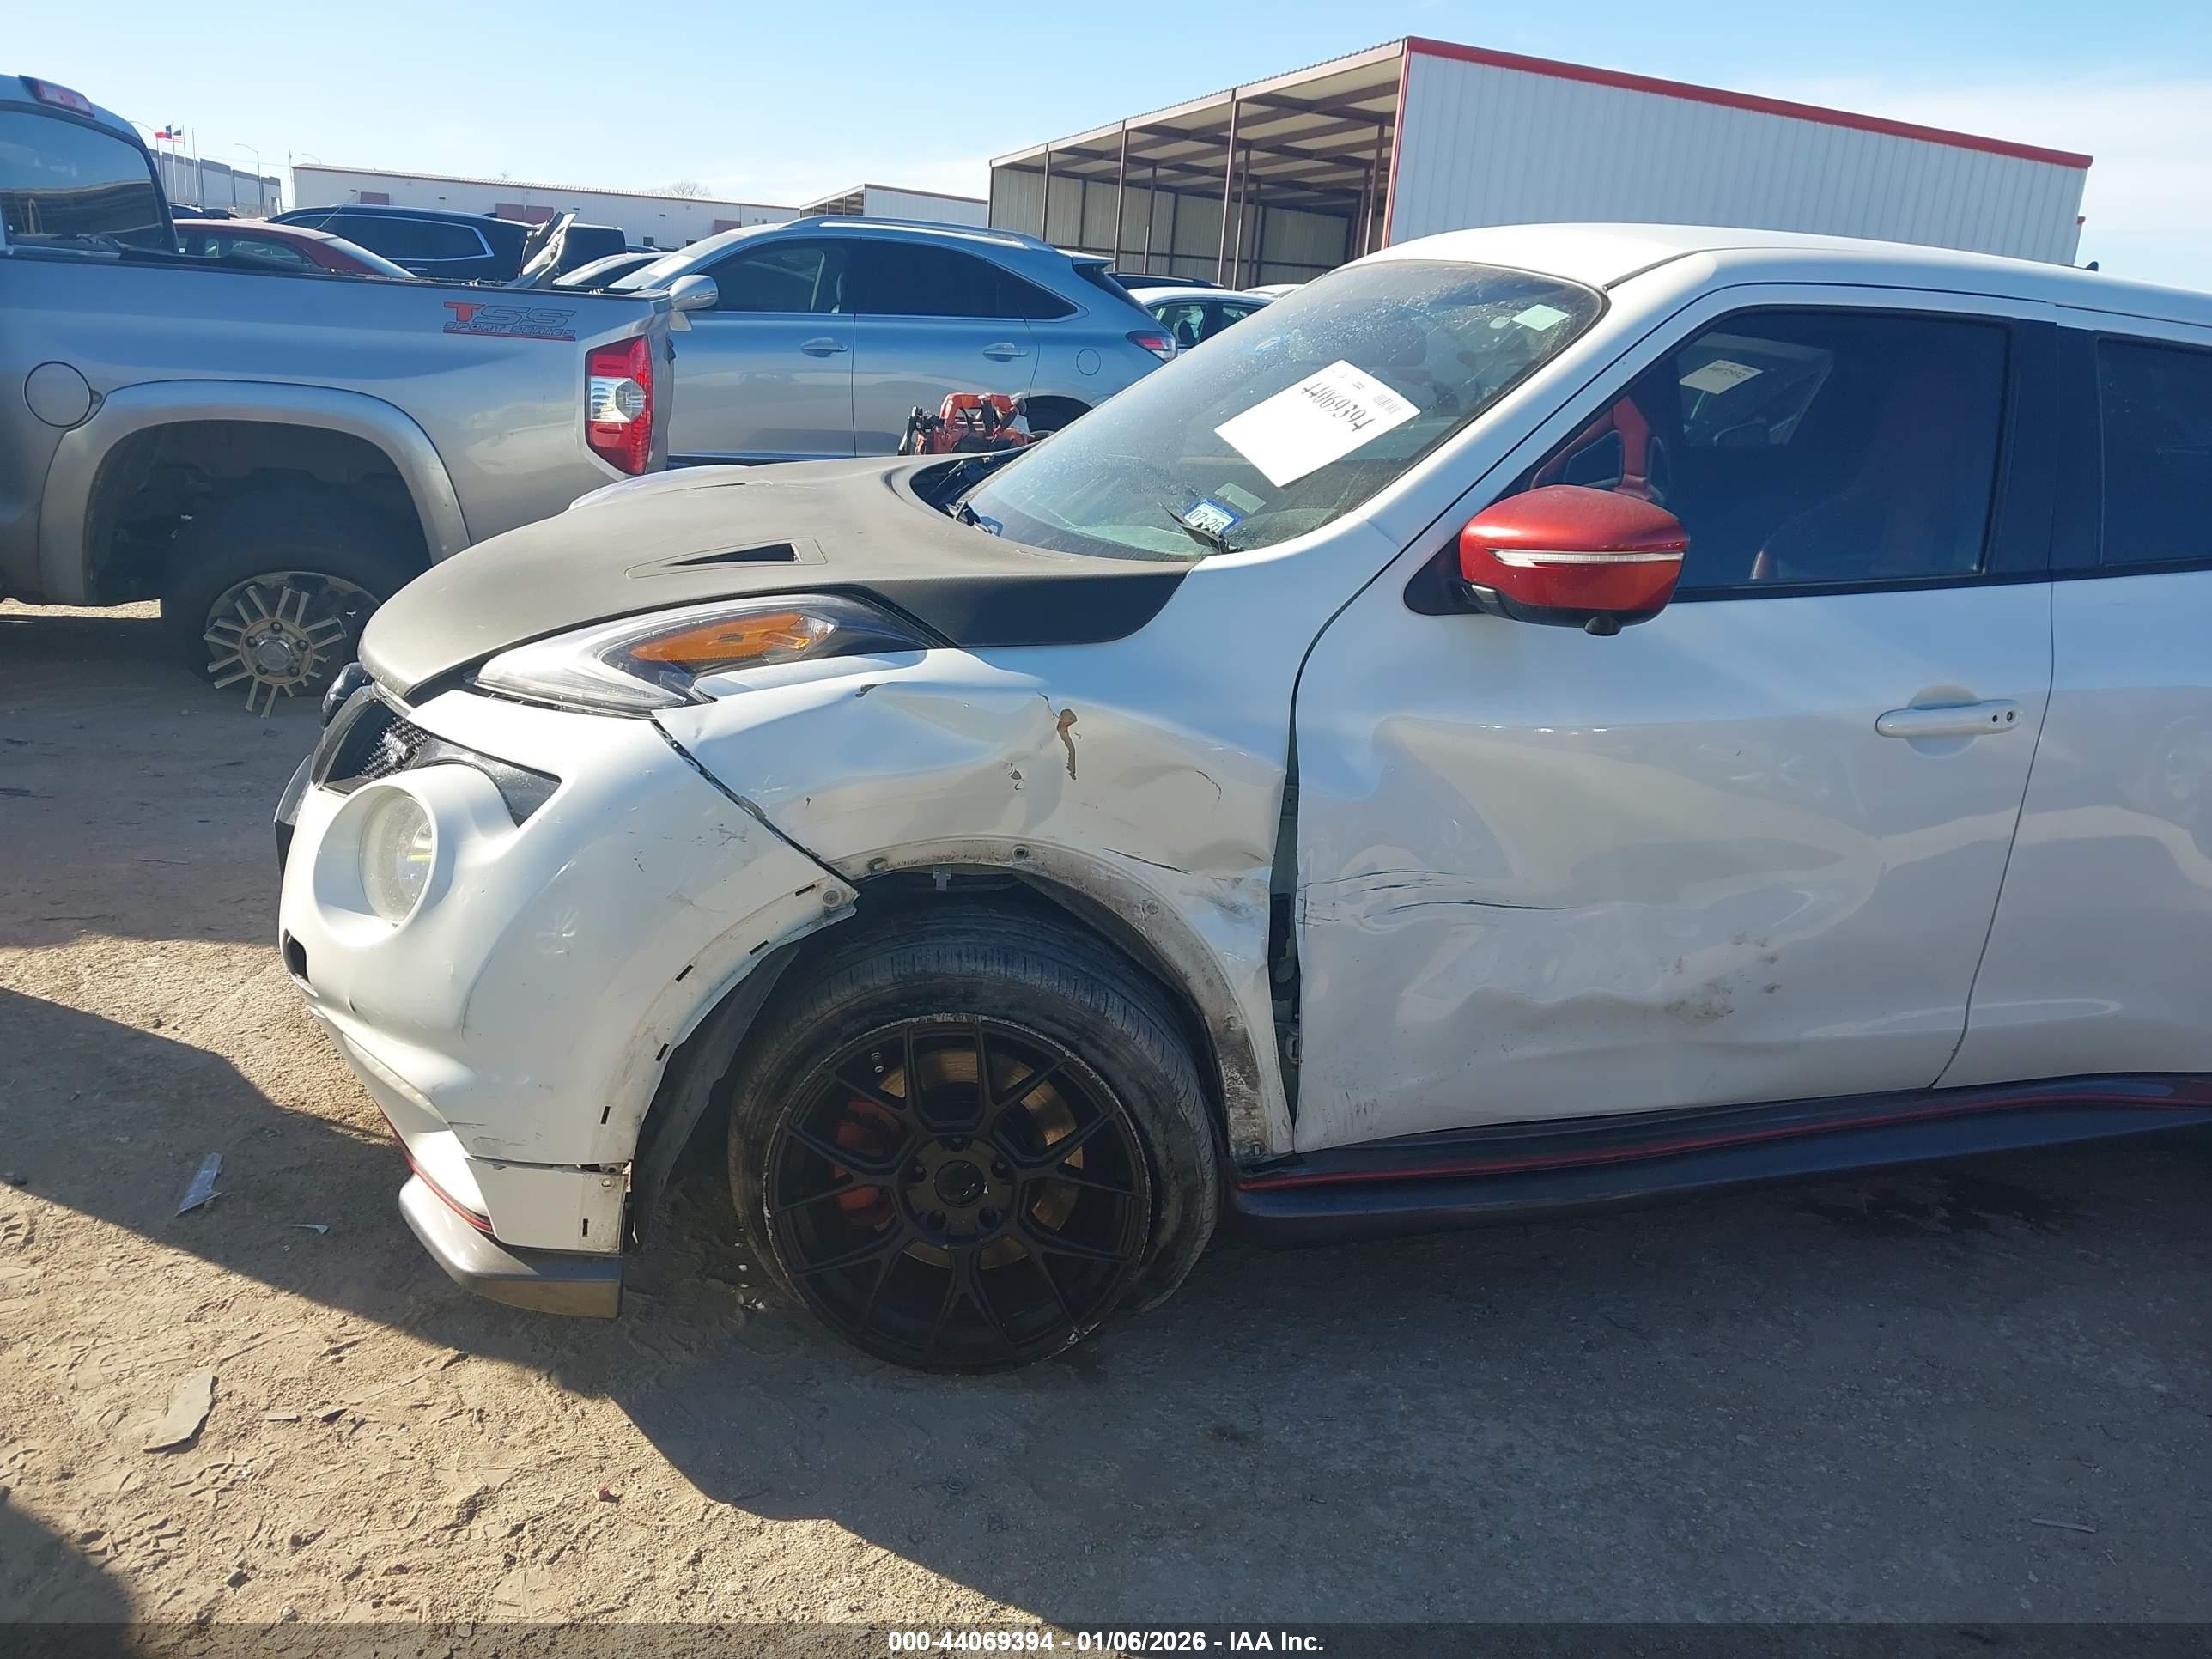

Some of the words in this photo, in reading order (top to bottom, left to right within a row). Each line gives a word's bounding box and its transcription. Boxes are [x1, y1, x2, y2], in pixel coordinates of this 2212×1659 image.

[444, 303, 576, 327] TSS
[444, 322, 507, 333] SPORT
[509, 326, 576, 337] SERIES
[1301, 381, 1376, 432] 44069394
